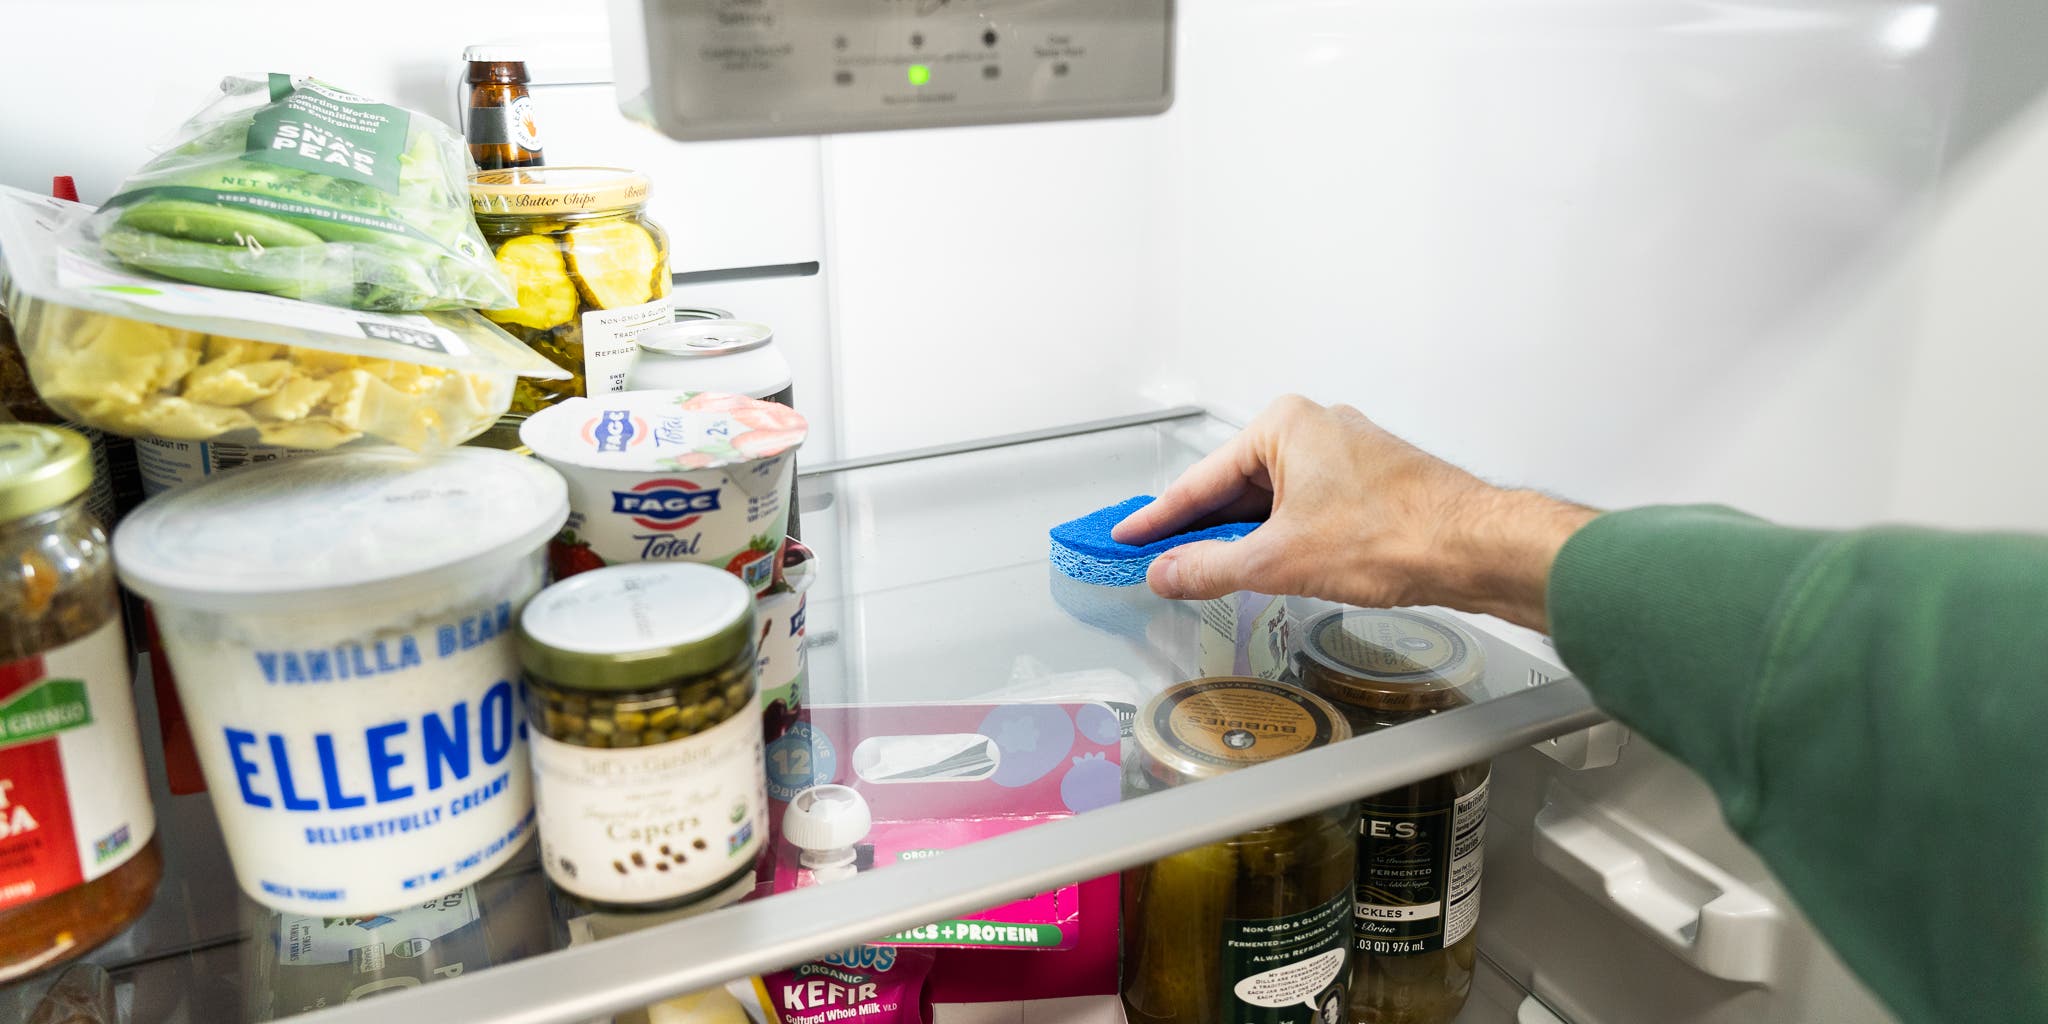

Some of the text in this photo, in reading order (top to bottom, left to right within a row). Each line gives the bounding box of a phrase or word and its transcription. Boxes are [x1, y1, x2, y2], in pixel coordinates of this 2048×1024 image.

[277, 125, 375, 165] SNAP
[272, 137, 375, 176] PEAS
[222, 176, 261, 188] NET
[516, 193, 559, 207] Butter
[563, 193, 597, 209] Chips
[249, 196, 331, 218] REFRIGERATED
[340, 213, 405, 233] PERISHABLE
[654, 415, 685, 447] Total
[620, 496, 712, 512] FAGE
[632, 532, 701, 560] Total
[254, 600, 512, 685] VANILLA BEAN
[1376, 622, 1397, 665] BUBBIES
[1187, 716, 1297, 733] BUBBIES
[771, 748, 811, 775] 12
[304, 770, 511, 845] DELIGHTFULLY CREAMY
[606, 816, 701, 845] Capers
[1360, 818, 1418, 838] IES
[1370, 868, 1432, 877] FERMENTED
[1301, 909, 1331, 926] GLUTEN
[1357, 907, 1402, 918] ICKLES
[1228, 940, 1279, 948] FERMENTED
[1294, 926, 1326, 942] NATURAL
[1361, 922, 1396, 934] Brine
[289, 943, 301, 962] FARMS
[1374, 942, 1389, 953] QT)
[1393, 942, 1410, 952] 976
[1412, 940, 1425, 951] mL
[817, 946, 897, 971] BUGS
[1252, 953, 1290, 962] ALWAYS
[799, 963, 864, 984] ORGANIC
[783, 980, 878, 1011] KEFIR
[827, 1007, 857, 1022] Whole
[859, 1003, 881, 1016] Milk
